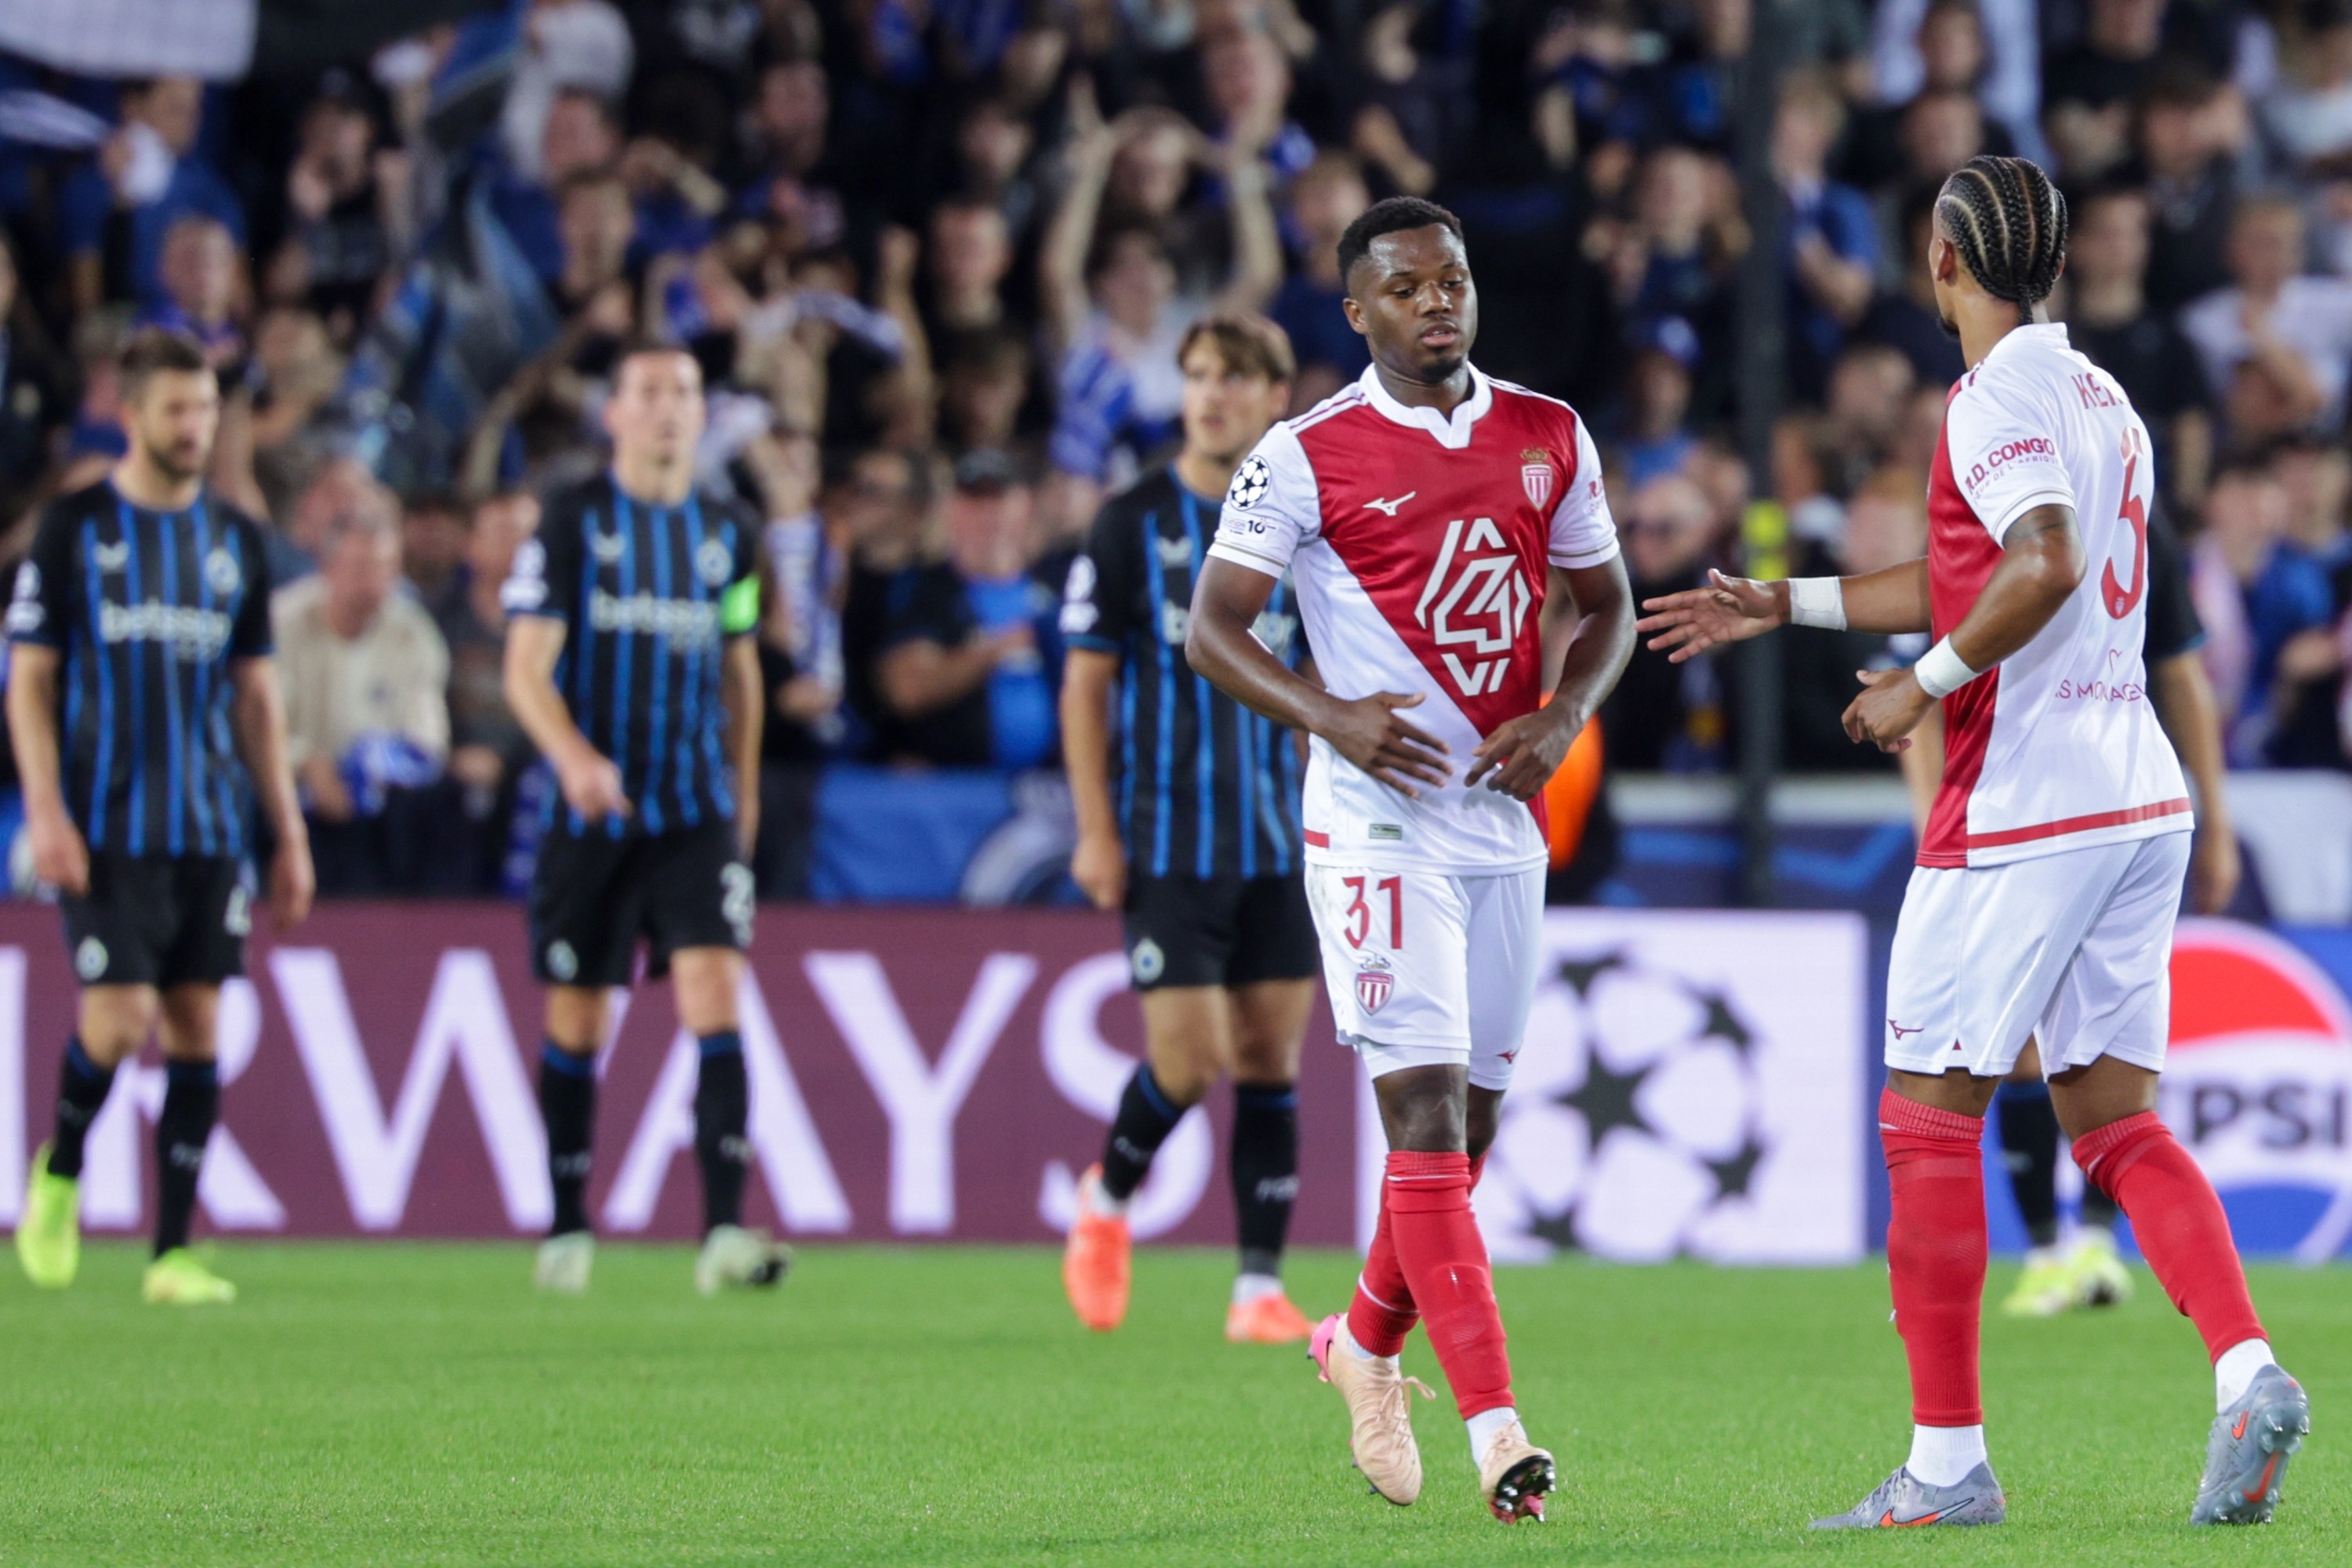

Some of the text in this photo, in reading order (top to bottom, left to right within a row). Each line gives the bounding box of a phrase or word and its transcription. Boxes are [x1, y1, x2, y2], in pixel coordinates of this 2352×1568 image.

[1988, 437, 2056, 468] CONGO
[2101, 426, 2147, 619] 5
[1341, 874, 1402, 950] 31
[2161, 1080, 2346, 1151] PSI
